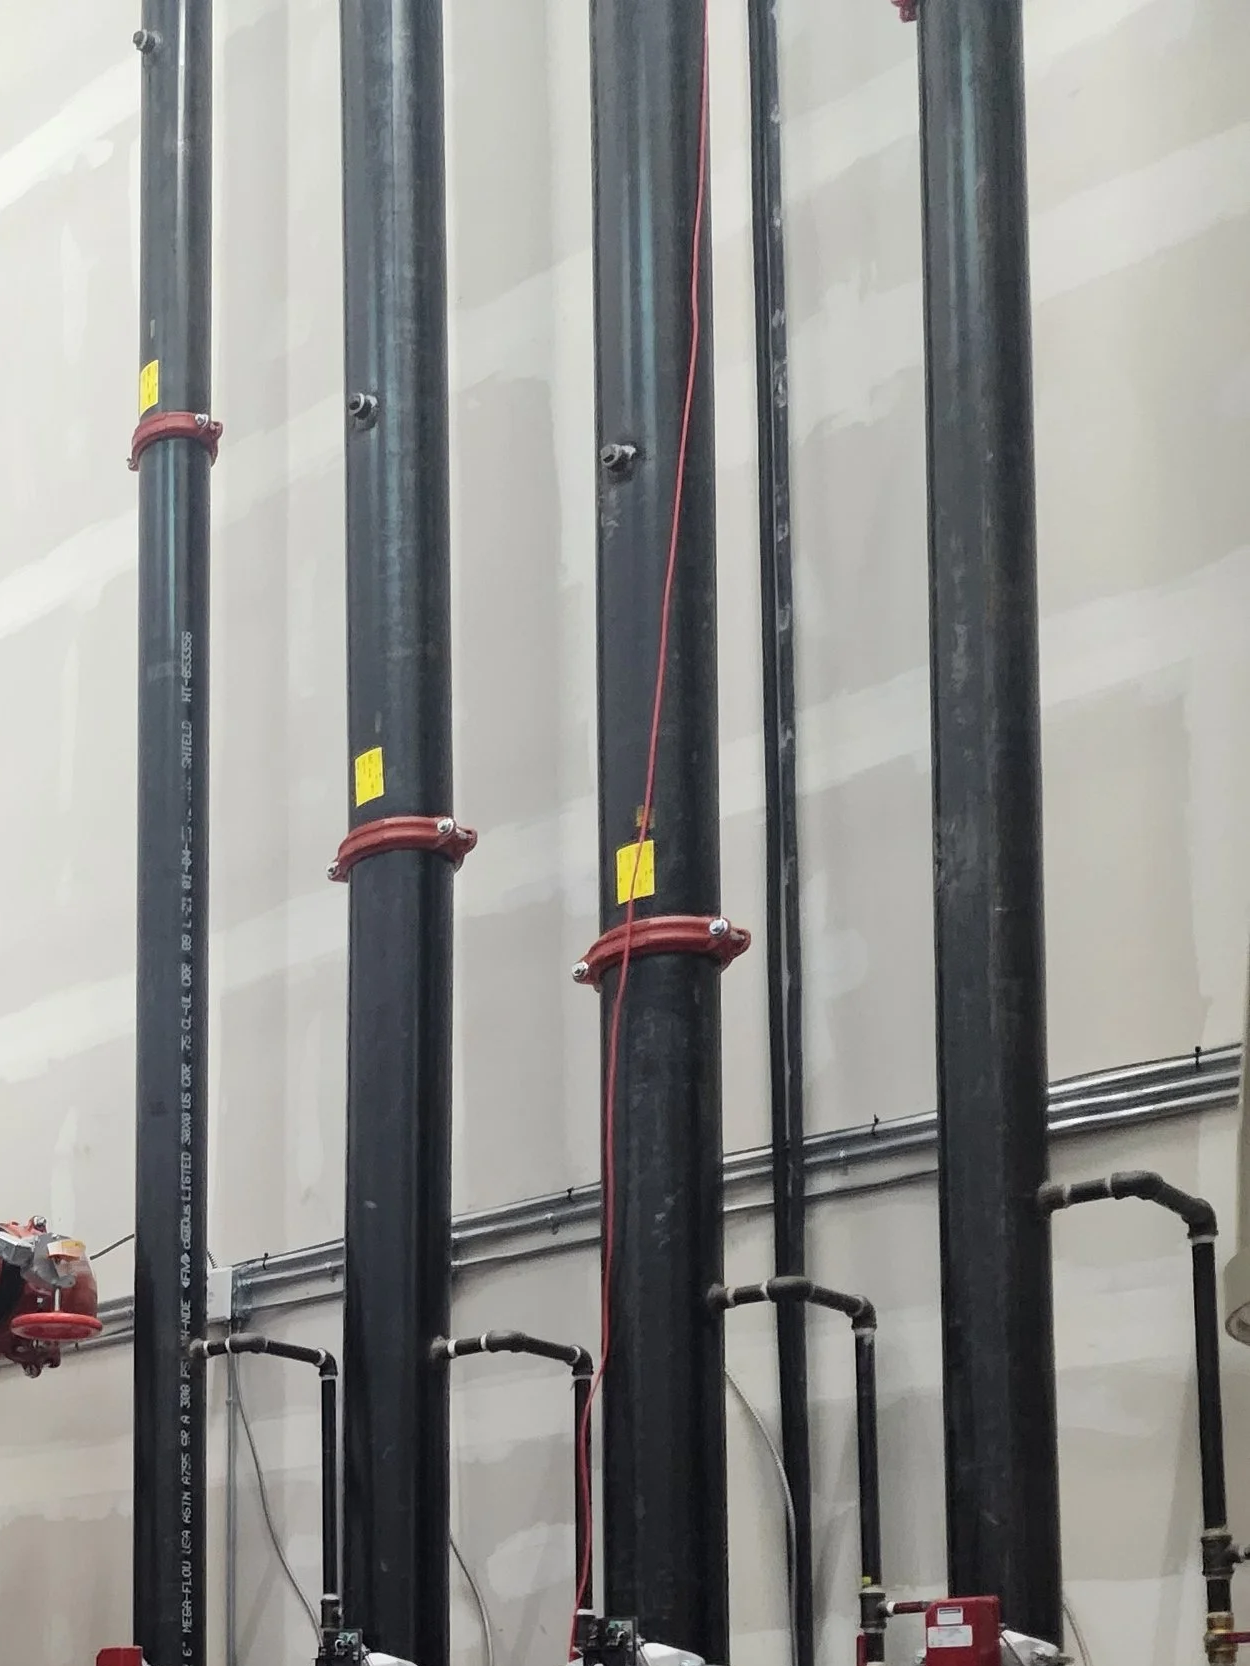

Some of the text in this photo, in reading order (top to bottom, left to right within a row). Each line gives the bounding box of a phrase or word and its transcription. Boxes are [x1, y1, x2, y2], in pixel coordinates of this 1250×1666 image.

[181, 721, 192, 770] SHIELD
[180, 1152, 191, 1201] LISTED
[180, 1384, 191, 1409] 300
[180, 1415, 190, 1425] A
[180, 1453, 191, 1486] A795
[181, 1530, 191, 1555] USA
